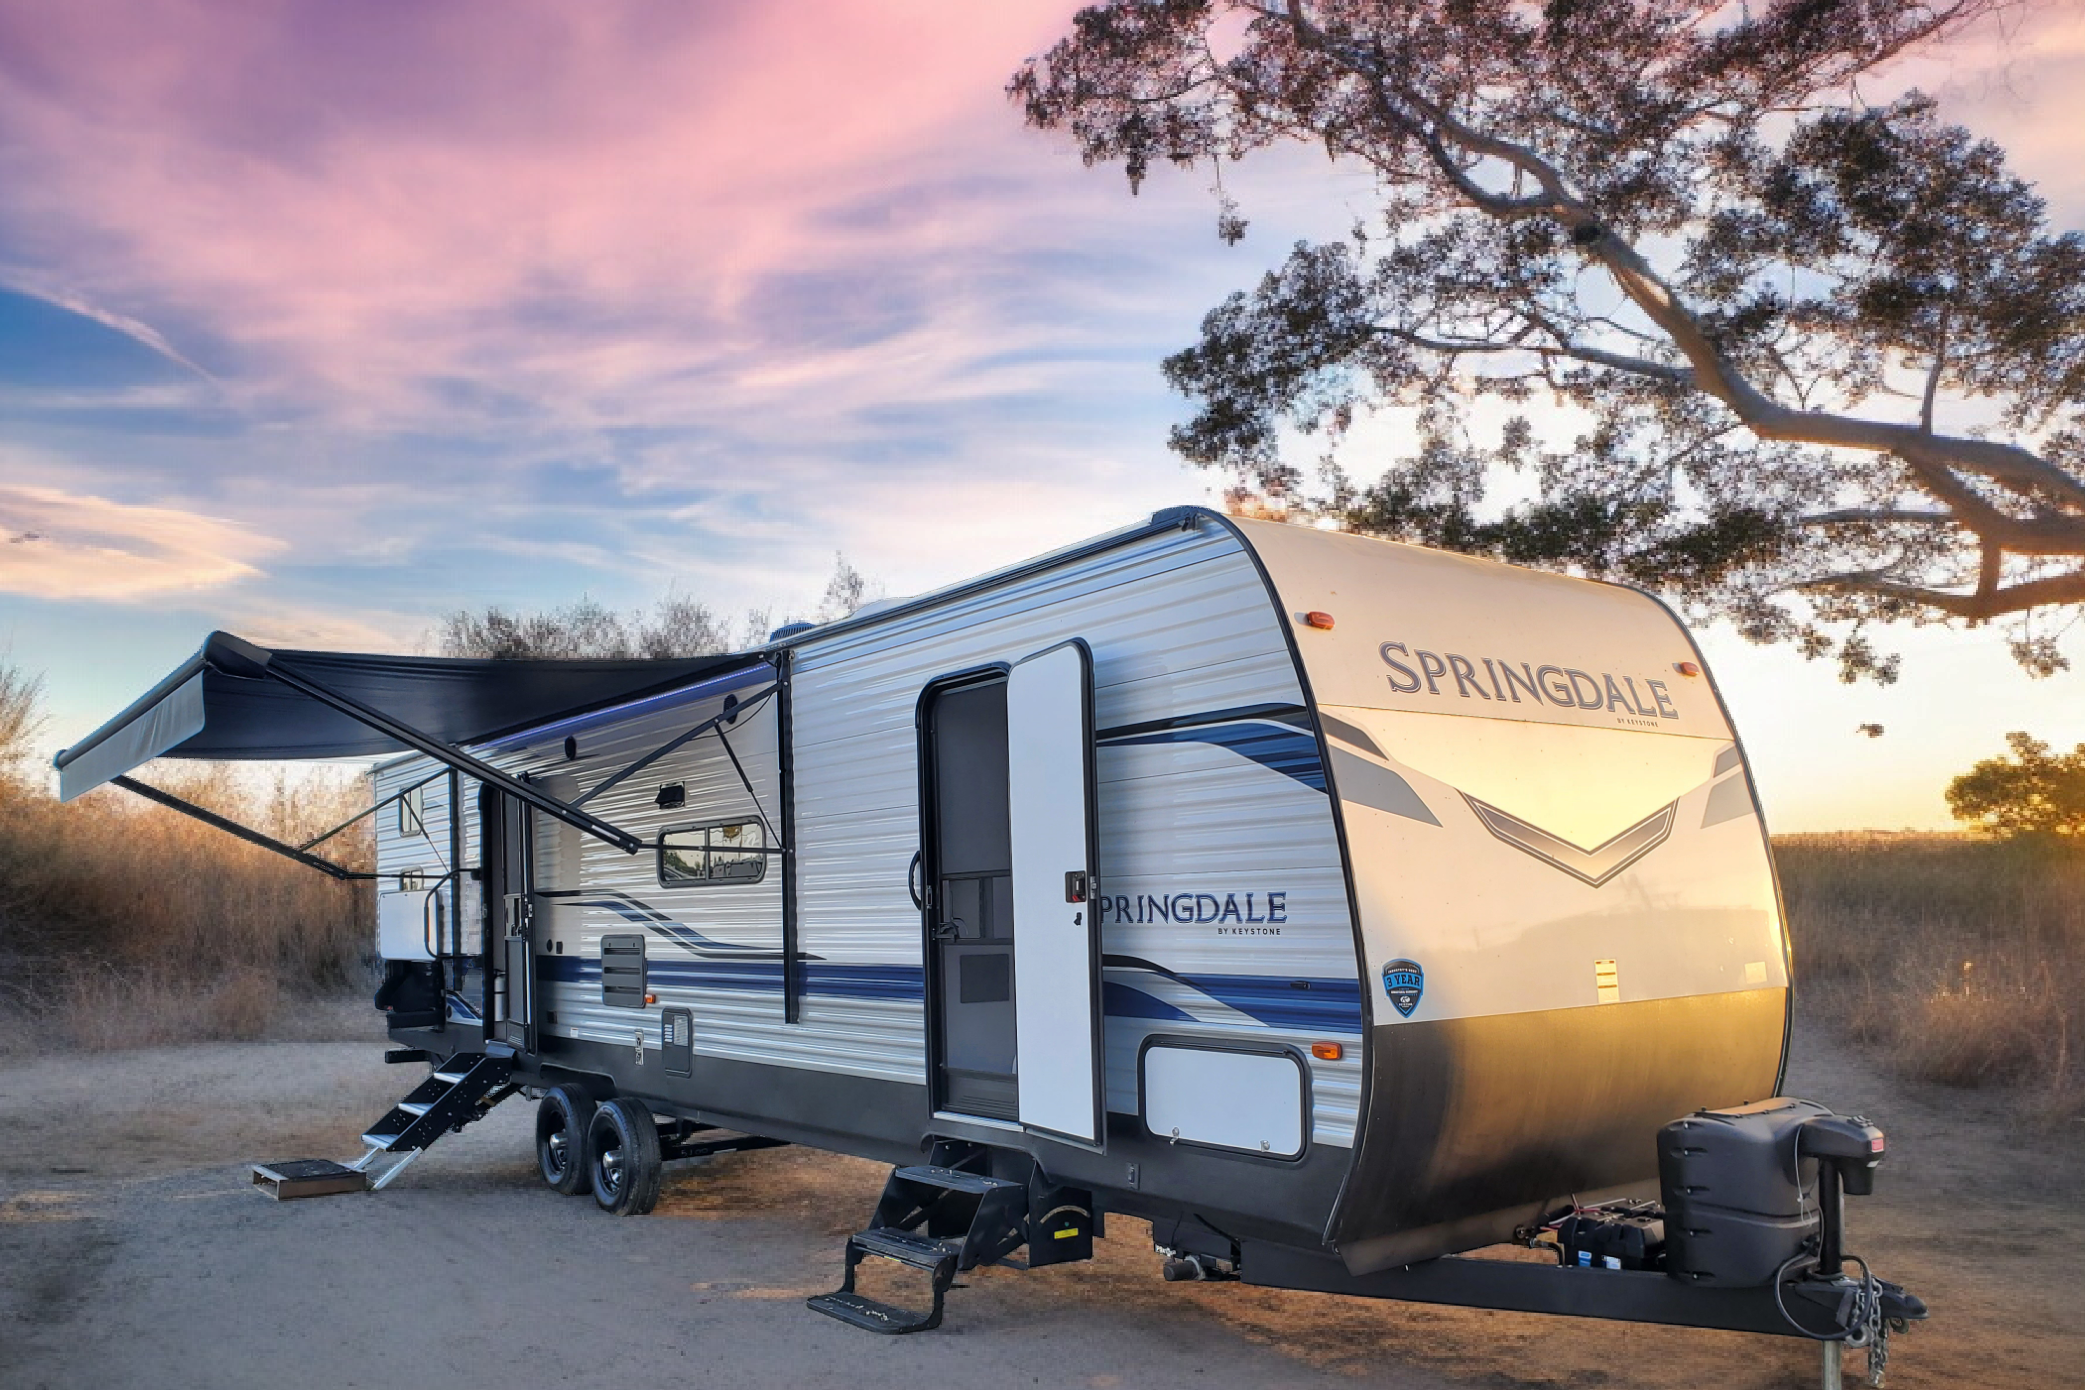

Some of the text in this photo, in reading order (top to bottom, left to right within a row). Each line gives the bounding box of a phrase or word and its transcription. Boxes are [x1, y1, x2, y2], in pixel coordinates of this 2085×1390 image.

[1378, 640, 1679, 720] SPRINGDALE
[1627, 719, 1659, 727] KEYSTONE
[1100, 891, 1288, 924] PRINGDALE
[1387, 974, 1420, 987] 3 YEAR
